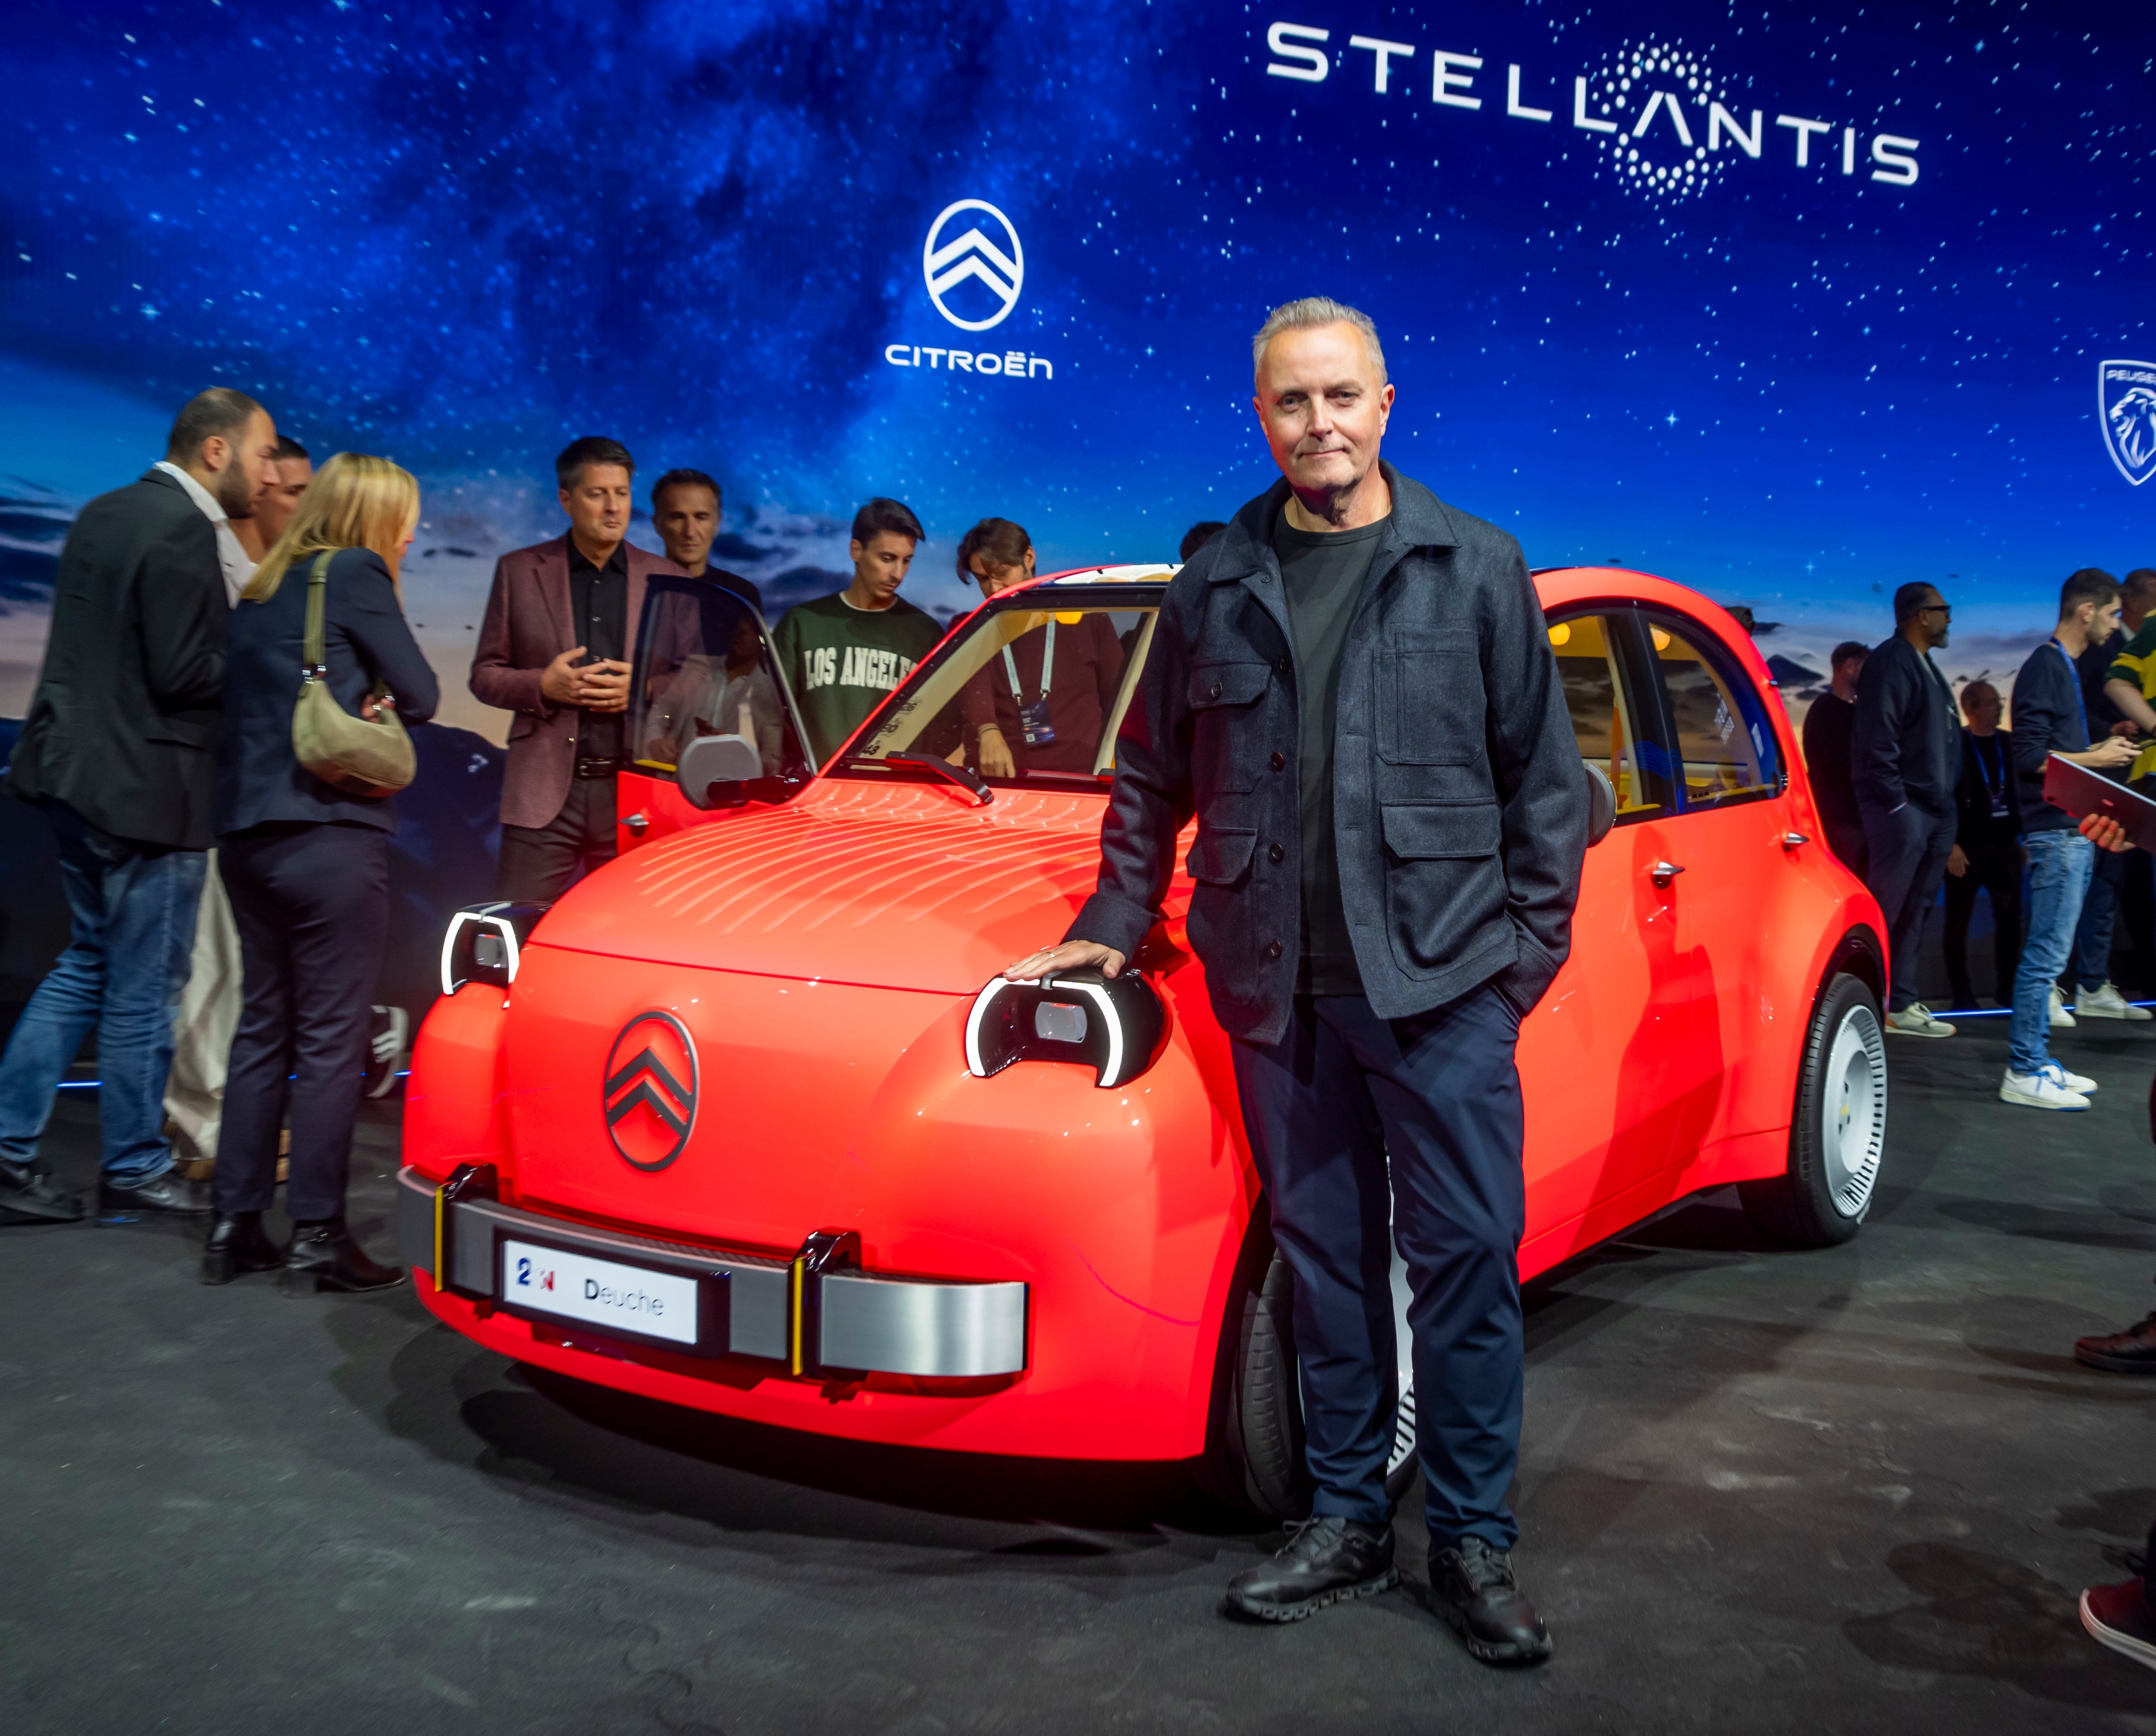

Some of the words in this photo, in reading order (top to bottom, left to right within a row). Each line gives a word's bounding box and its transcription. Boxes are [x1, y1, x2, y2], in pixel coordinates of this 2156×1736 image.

[1266, 21, 1920, 186] STELLANTIS
[2106, 369, 2156, 385] PEUGE
[804, 647, 837, 689] LOS
[839, 647, 918, 691] ANGELE
[584, 1278, 664, 1316] Deuche
